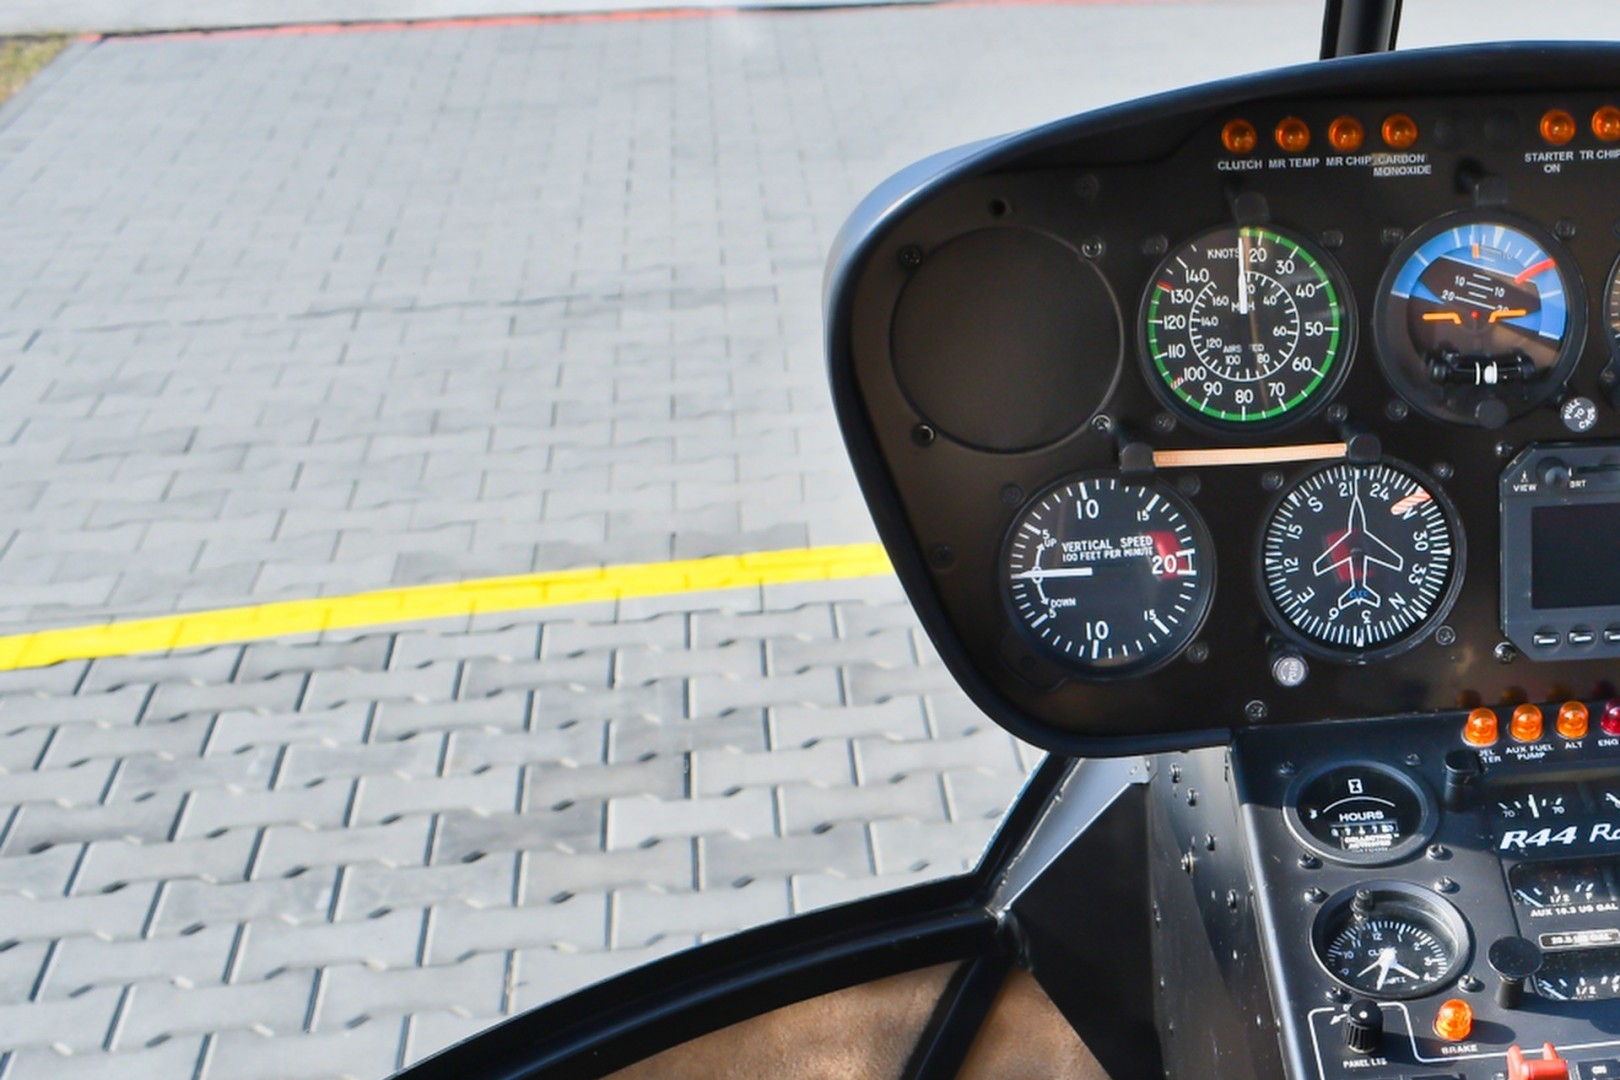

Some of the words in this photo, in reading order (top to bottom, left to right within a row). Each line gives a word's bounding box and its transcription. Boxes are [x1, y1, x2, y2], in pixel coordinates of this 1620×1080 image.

[1326, 157, 1342, 166] MR
[1345, 156, 1372, 165] CHIP
[1378, 154, 1425, 163] CARBON
[1525, 152, 1574, 162] STARTER
[1580, 151, 1593, 160] TR
[1217, 160, 1262, 170] CLUTCH
[1269, 159, 1285, 168] MR
[1289, 158, 1320, 168] TEMP
[1544, 164, 1560, 173] ON
[1373, 165, 1431, 176] MONOXIDE
[1249, 248, 1267, 262] 20
[1276, 260, 1294, 274] 30
[1185, 269, 1209, 283] 140
[1163, 315, 1185, 329] 120
[1305, 322, 1324, 335] 50
[1184, 367, 1206, 381] 100
[1235, 390, 1253, 403] 80
[1339, 482, 1353, 497] 21
[1370, 483, 1389, 500] 24
[1513, 484, 1536, 492] VIEW
[1077, 499, 1099, 519] 10
[1308, 497, 1323, 512] S
[1287, 524, 1303, 539] 15
[1062, 540, 1111, 552] VERTICAL
[1121, 536, 1153, 547] SPEED
[1414, 531, 1428, 550] 30
[1062, 552, 1078, 562] 100
[1080, 551, 1101, 560] FEET
[1104, 550, 1121, 558] PER
[1124, 547, 1153, 557] MINUTE
[1152, 555, 1176, 574] 20
[1284, 557, 1299, 572] 12
[1051, 598, 1075, 607] DOWN
[1565, 742, 1583, 750] ALT
[1598, 738, 1619, 746] ENG
[1506, 746, 1527, 755] AUX
[1530, 744, 1554, 752] FUEL
[1517, 752, 1545, 760] PUMP
[1339, 811, 1383, 821] HOURS
[1500, 826, 1578, 850] R44
[1442, 1045, 1477, 1054] BRAKE
[1343, 1059, 1368, 1068] PANEL
[1370, 1058, 1387, 1066] LTS
